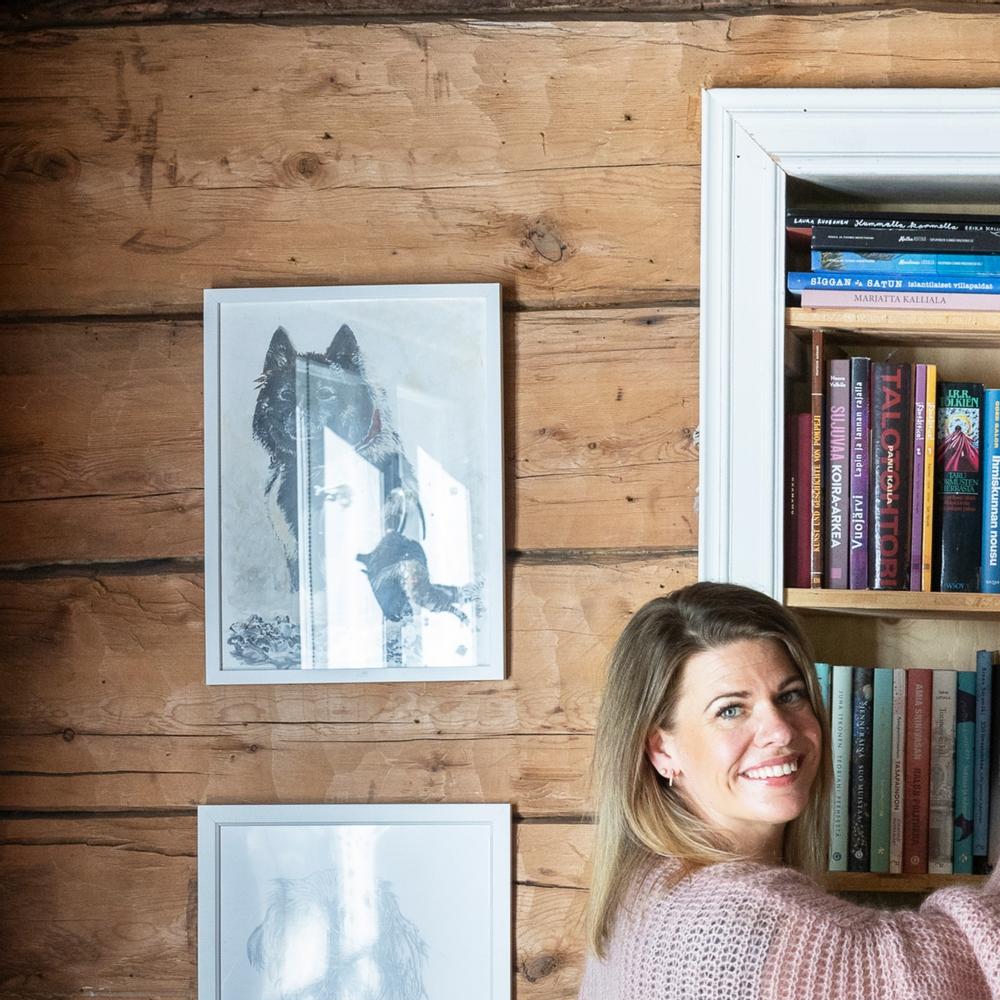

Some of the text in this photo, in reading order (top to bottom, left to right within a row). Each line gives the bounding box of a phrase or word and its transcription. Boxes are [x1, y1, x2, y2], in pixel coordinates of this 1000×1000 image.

[810, 278, 851, 286] SIGGAN
[867, 279, 902, 288] SATUN
[854, 295, 946, 304] MARJATTA KALLIALA
[854, 412, 862, 439] lannan
[831, 406, 845, 548] SUJUVAA KOIRA-ARKEA
[854, 454, 863, 477] Lapin
[852, 495, 864, 549] Vuojärvi
[990, 455, 1000, 566] Ihmiskunnan nousu
